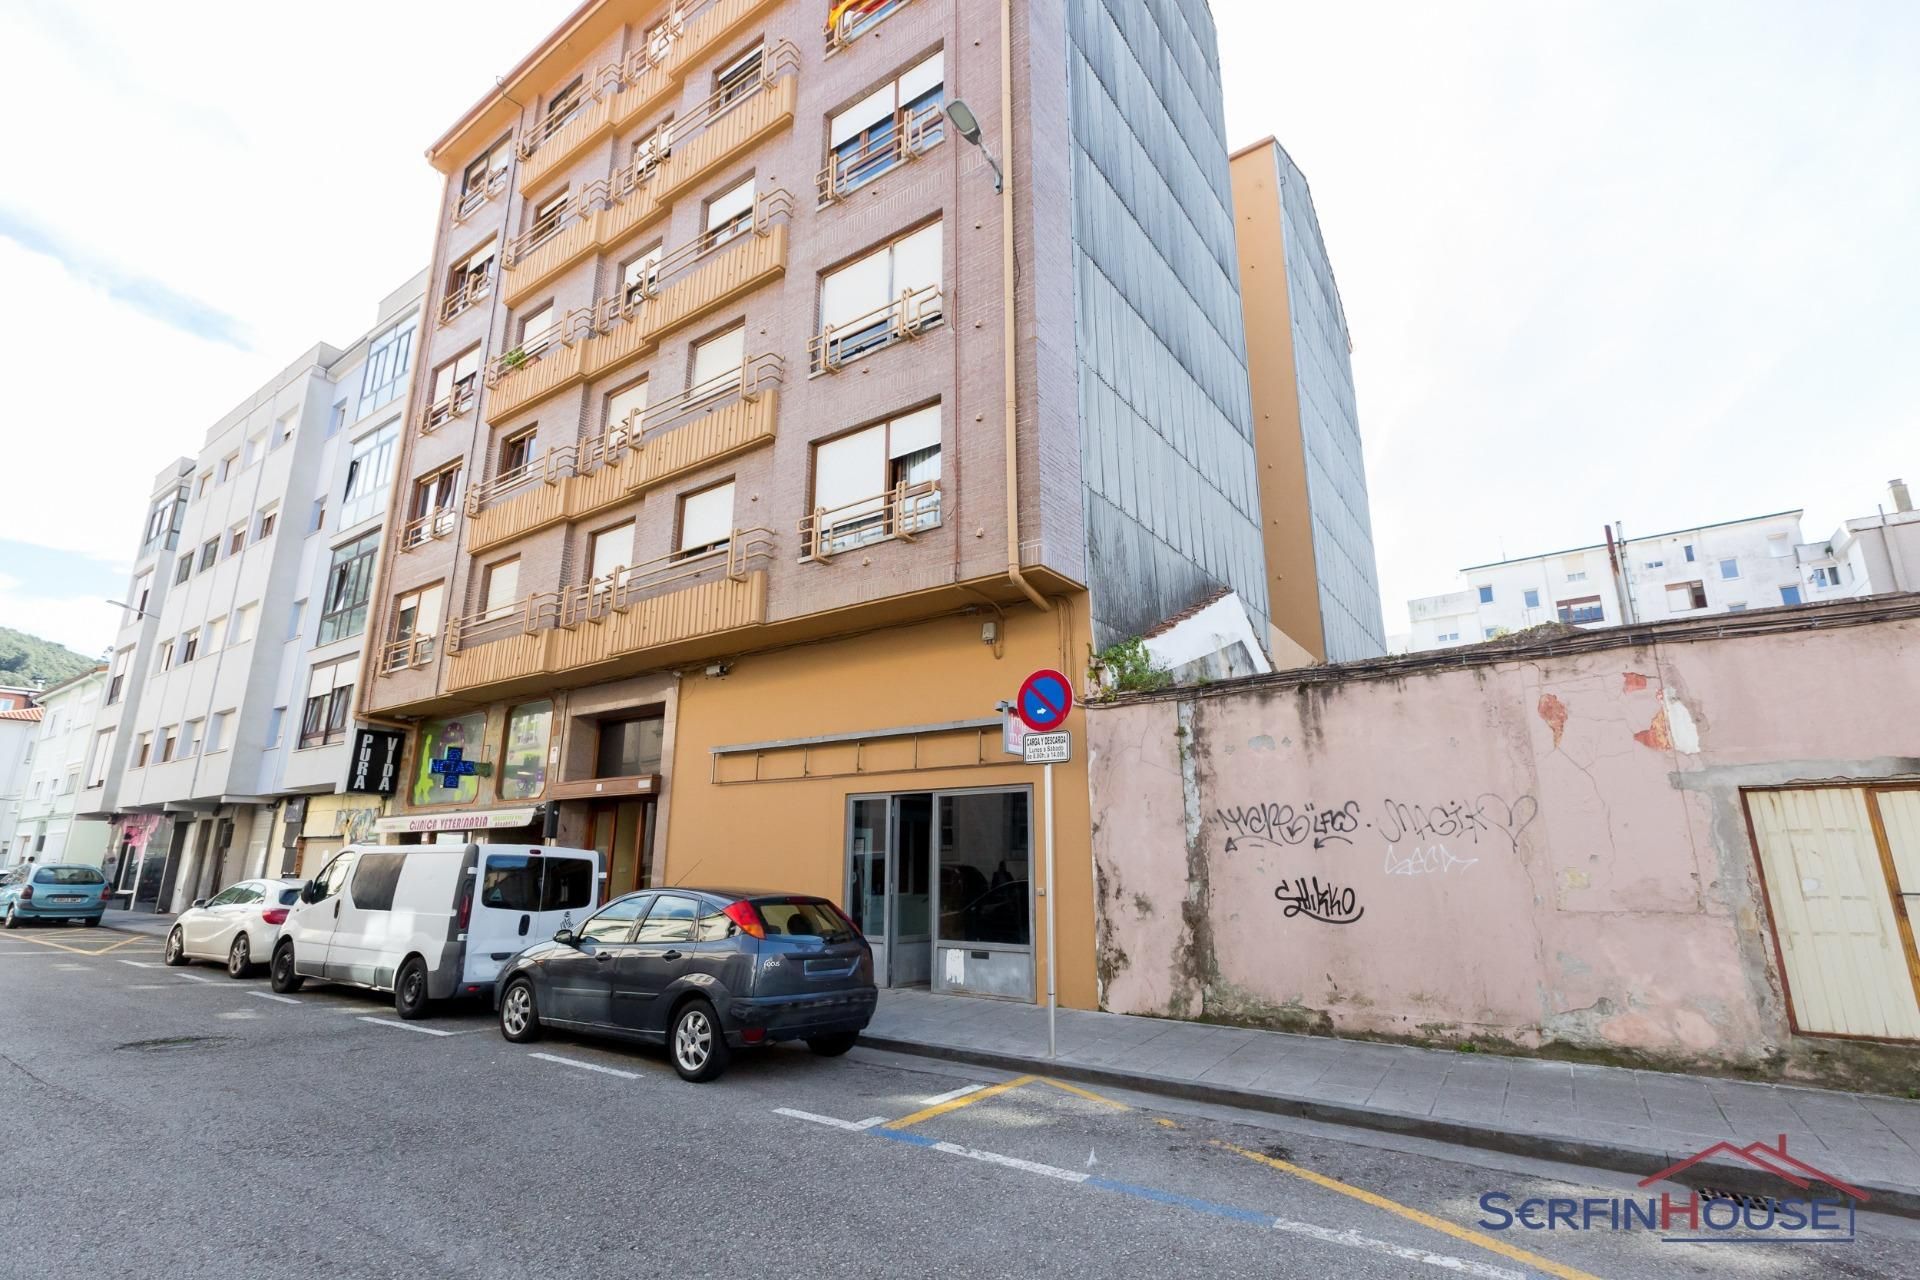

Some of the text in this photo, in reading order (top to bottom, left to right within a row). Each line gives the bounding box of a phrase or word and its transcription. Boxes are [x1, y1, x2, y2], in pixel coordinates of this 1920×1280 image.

[1026, 737, 1041, 746] CARGA
[1045, 735, 1066, 745] DESCARGA
[353, 734, 374, 790] PURA
[378, 737, 398, 791] VIDA
[440, 816, 488, 830] VETERINARIA
